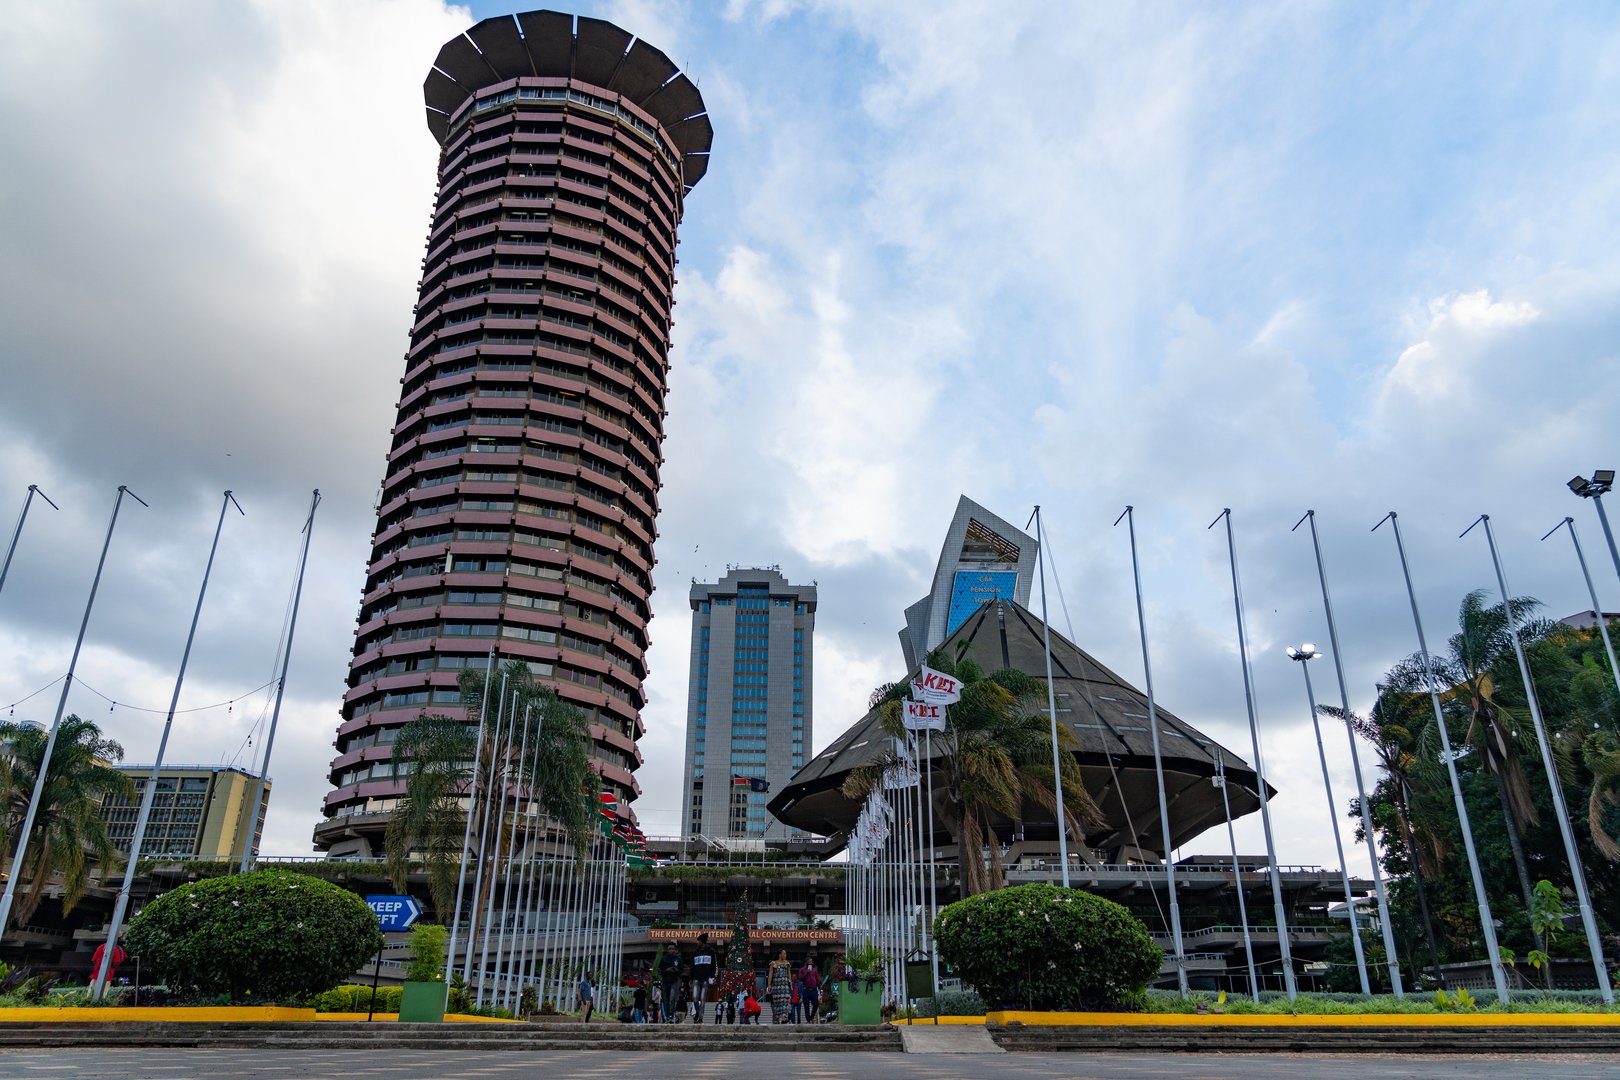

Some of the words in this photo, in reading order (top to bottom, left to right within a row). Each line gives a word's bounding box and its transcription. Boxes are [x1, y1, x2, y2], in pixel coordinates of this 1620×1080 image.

[367, 901, 403, 912] KEEP
[376, 914, 399, 925] FT
[650, 930, 665, 938] THE
[665, 930, 702, 938] KENYATTA
[704, 931, 760, 939] NTERNAAL
[761, 931, 809, 939] CONVENTION
[809, 931, 838, 939] CENTRE
